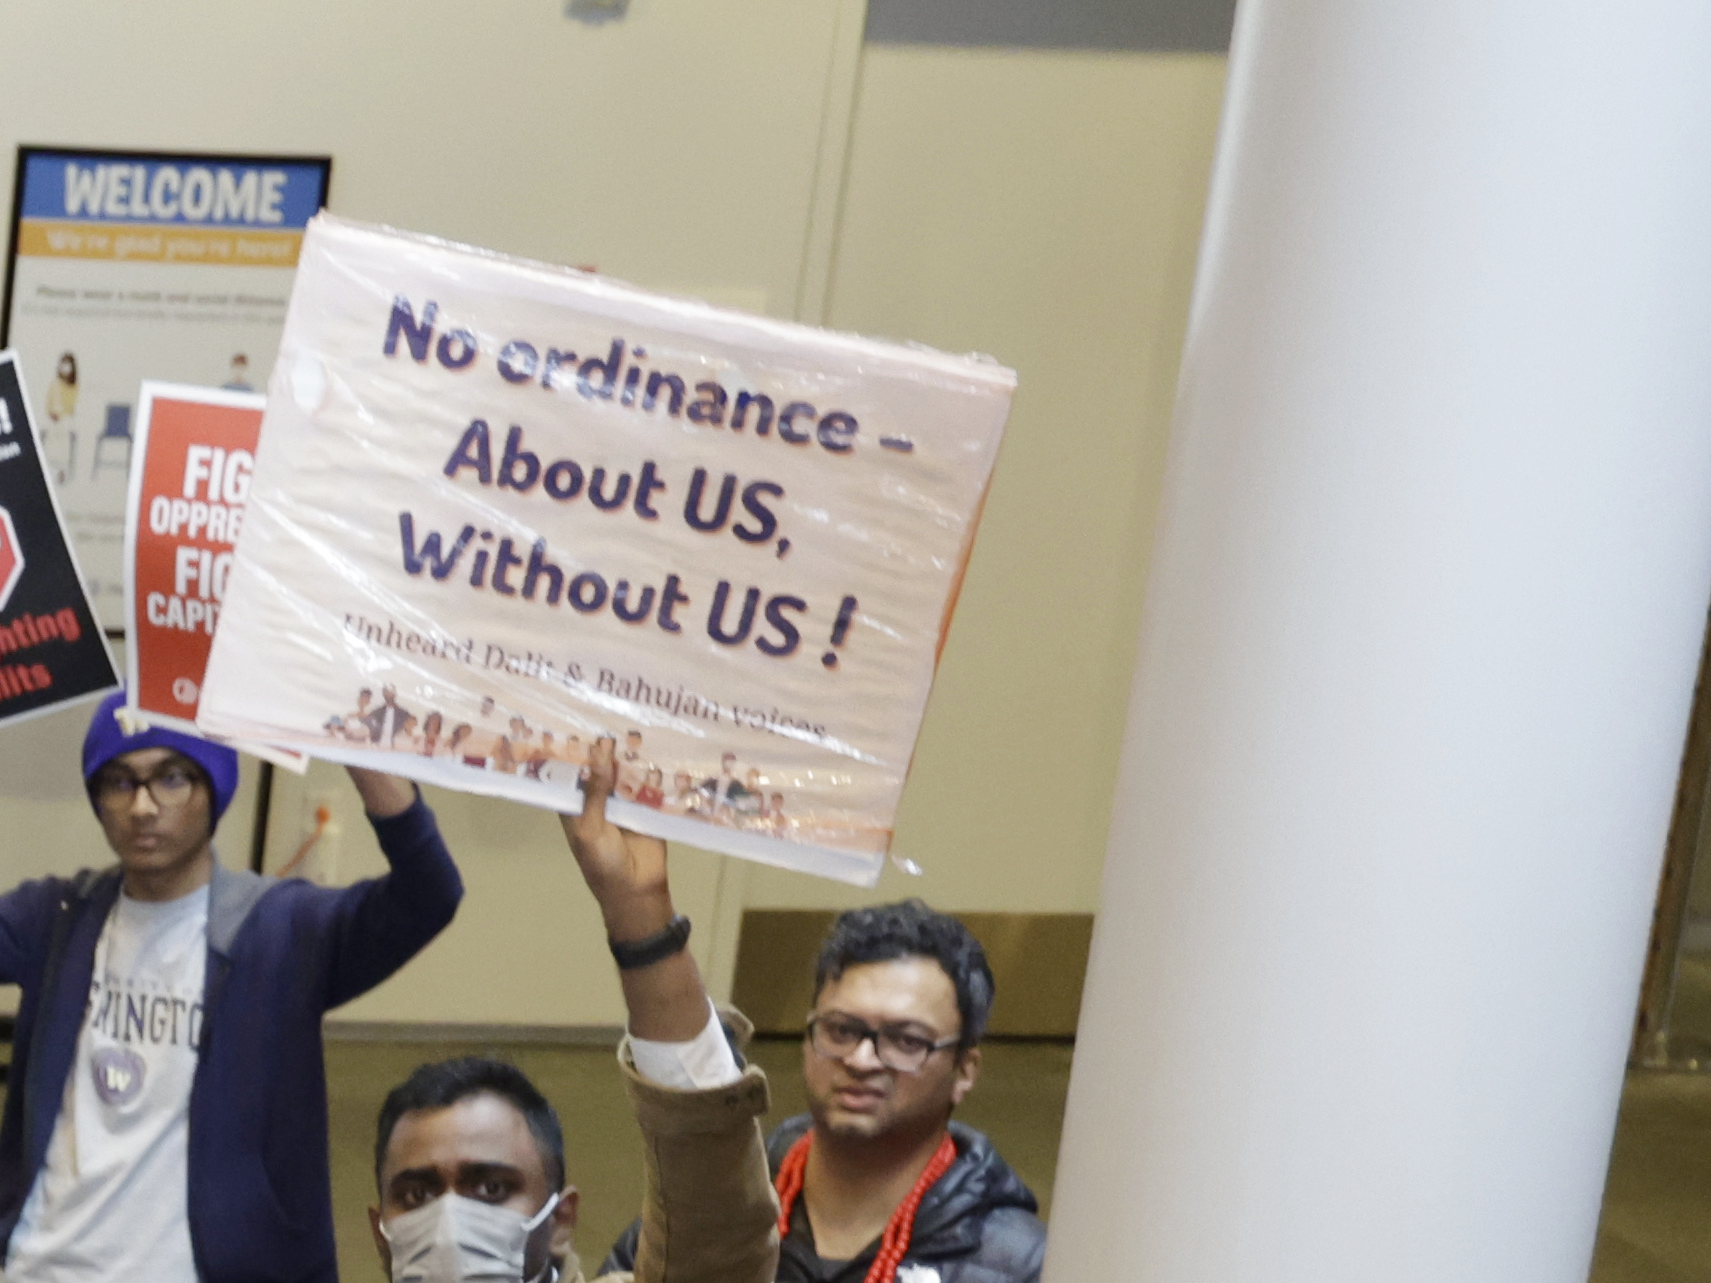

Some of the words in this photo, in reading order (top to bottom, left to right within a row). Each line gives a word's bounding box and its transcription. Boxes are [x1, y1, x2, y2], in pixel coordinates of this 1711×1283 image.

[64, 162, 288, 224] WELCOME
[384, 295, 477, 369] No
[495, 340, 859, 455] ordinance
[149, 496, 244, 545] OPPRE
[183, 443, 255, 501] FIG
[443, 419, 665, 520] About
[682, 467, 792, 560] US,
[398, 511, 691, 634] Without
[705, 580, 807, 659] US
[343, 612, 475, 666] Unheard
[482, 642, 555, 682] Dalit
[595, 669, 722, 724] Bahujan
